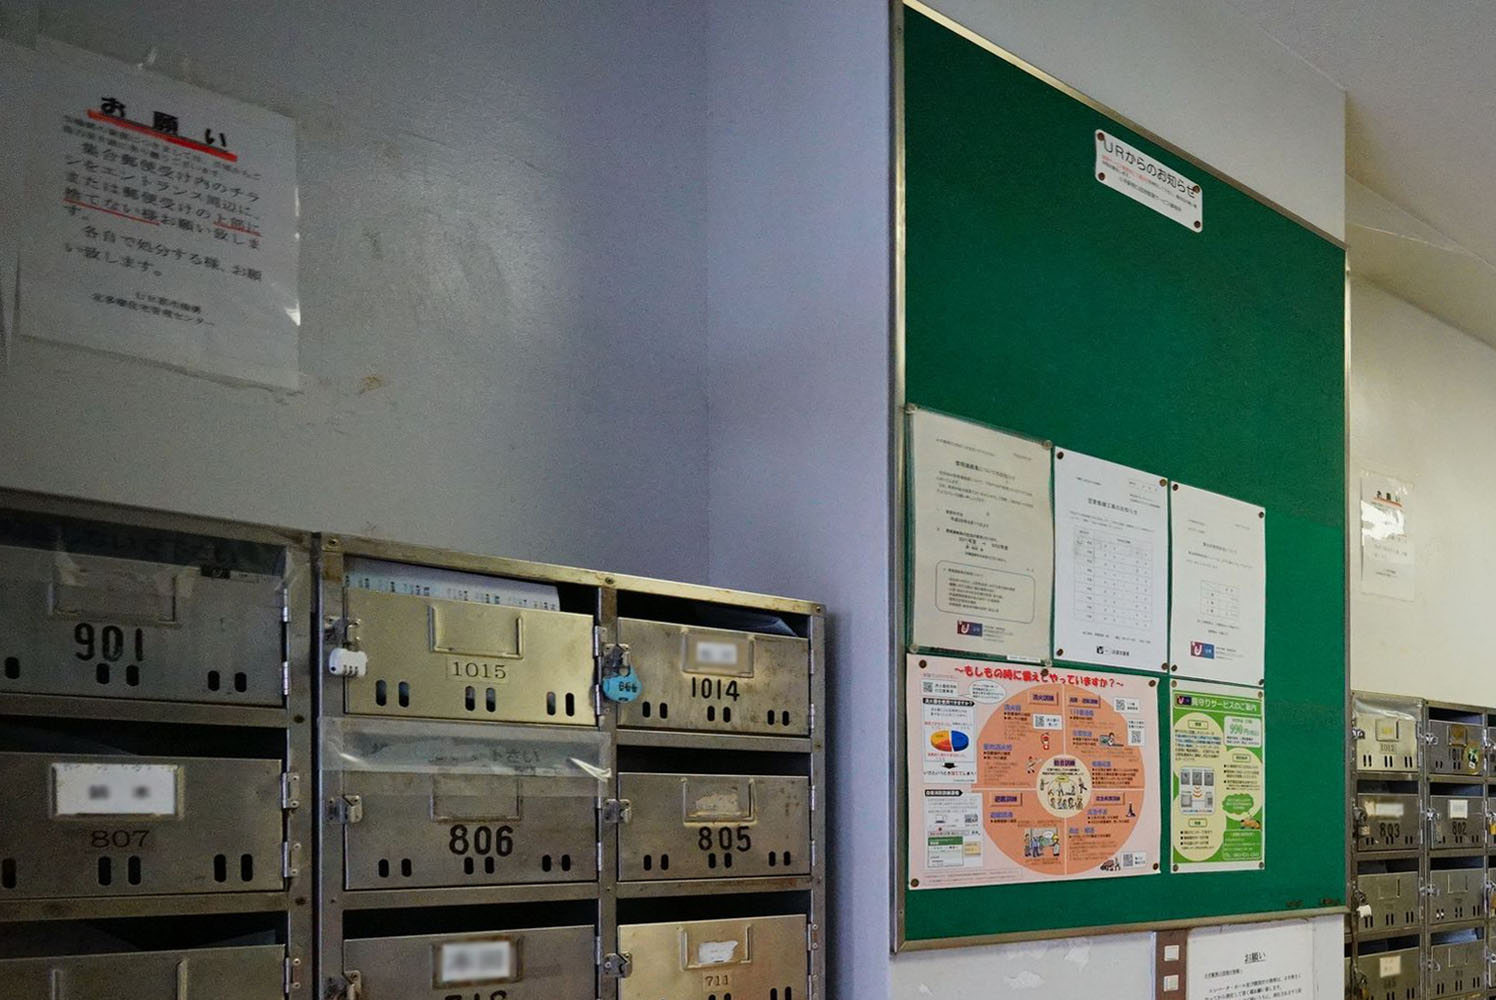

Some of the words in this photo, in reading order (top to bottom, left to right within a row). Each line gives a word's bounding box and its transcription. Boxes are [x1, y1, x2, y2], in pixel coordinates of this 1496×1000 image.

[74, 622, 144, 662] 901
[453, 661, 506, 679] 1015
[691, 677, 740, 702] 1014
[90, 829, 151, 849] 807
[448, 825, 513, 857] 806
[698, 826, 752, 852] 805
[1379, 822, 1400, 839] 803
[705, 975, 730, 987] 711
